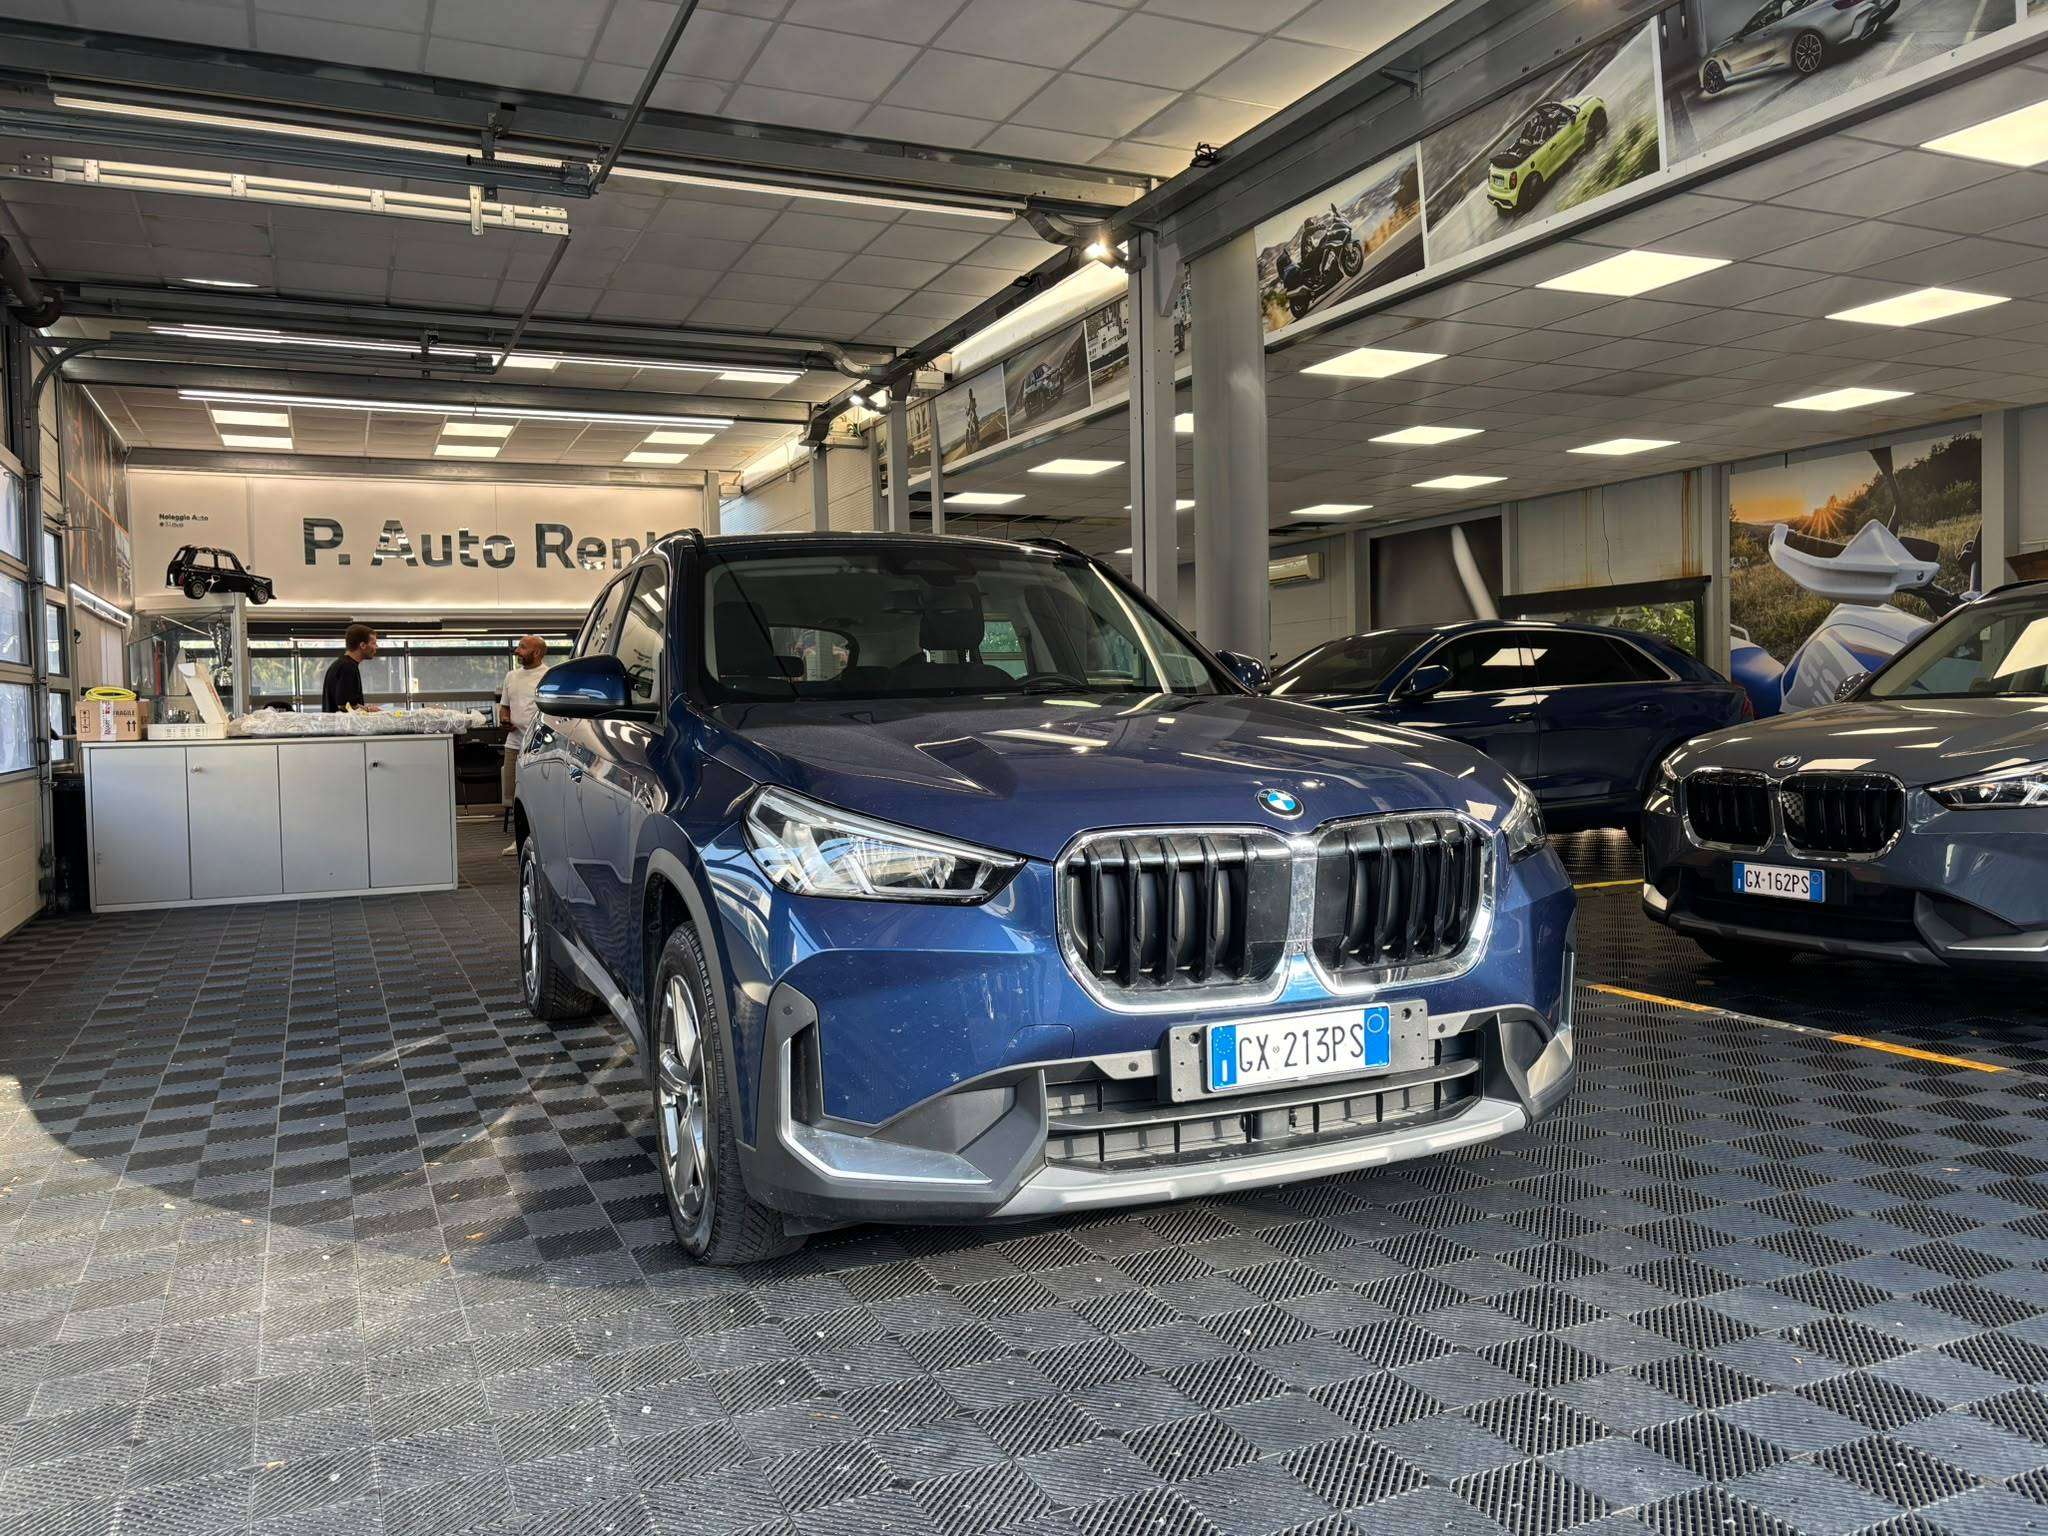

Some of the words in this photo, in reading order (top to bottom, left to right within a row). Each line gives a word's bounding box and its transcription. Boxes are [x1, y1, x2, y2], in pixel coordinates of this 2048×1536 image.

[303, 518, 351, 565] P.
[371, 520, 516, 569] Auto
[535, 523, 656, 570] Ren
